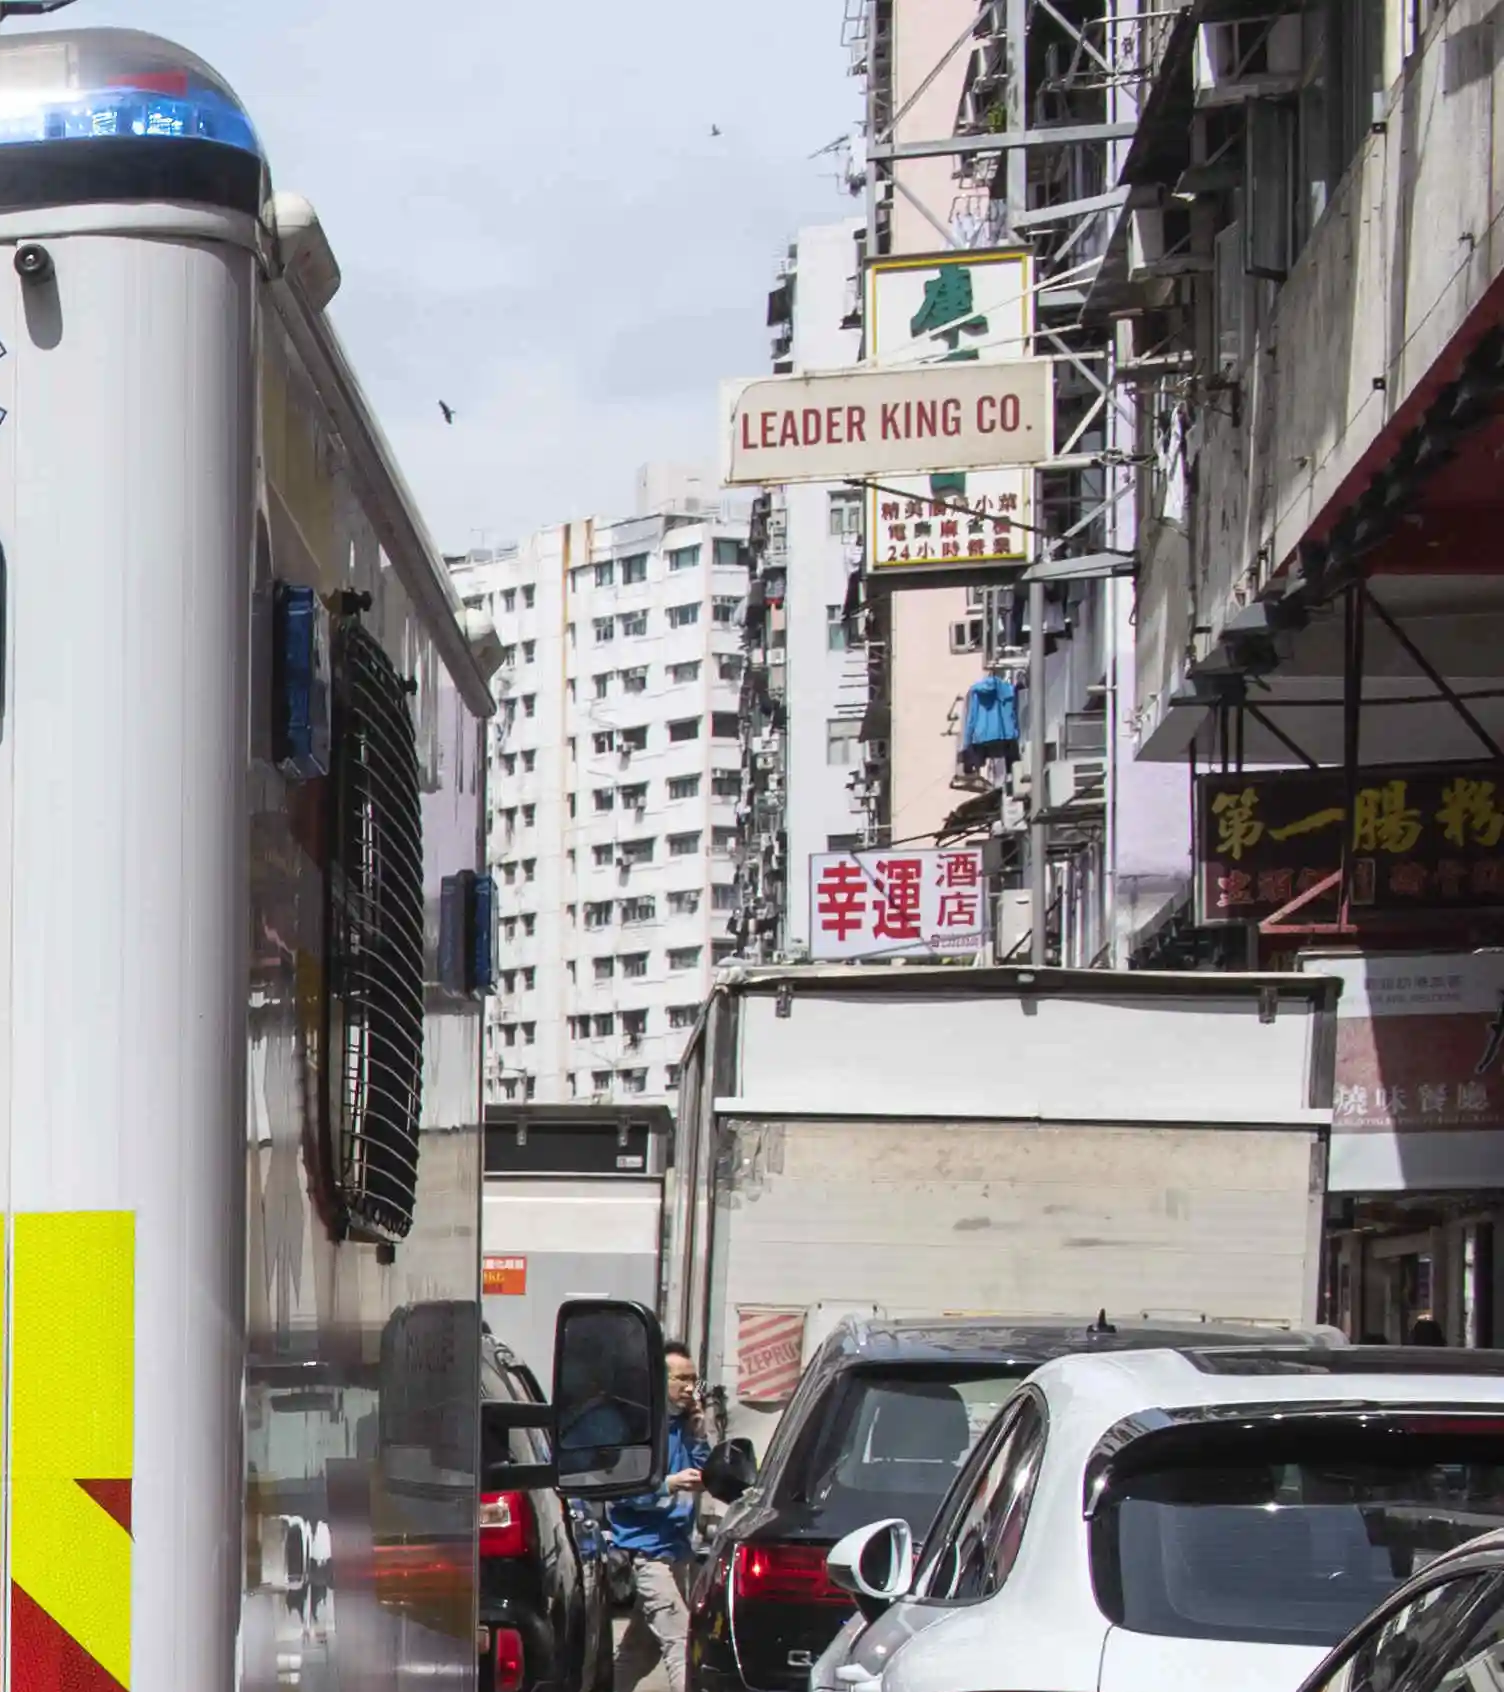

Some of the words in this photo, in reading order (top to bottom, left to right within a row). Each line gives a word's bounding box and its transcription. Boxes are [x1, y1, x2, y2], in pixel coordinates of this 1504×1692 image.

[741, 405, 866, 450] LEADER
[881, 398, 961, 441] KING
[976, 393, 1033, 434] CO.
[817, 861, 922, 941] 幸運
[935, 853, 979, 928] 酒店
